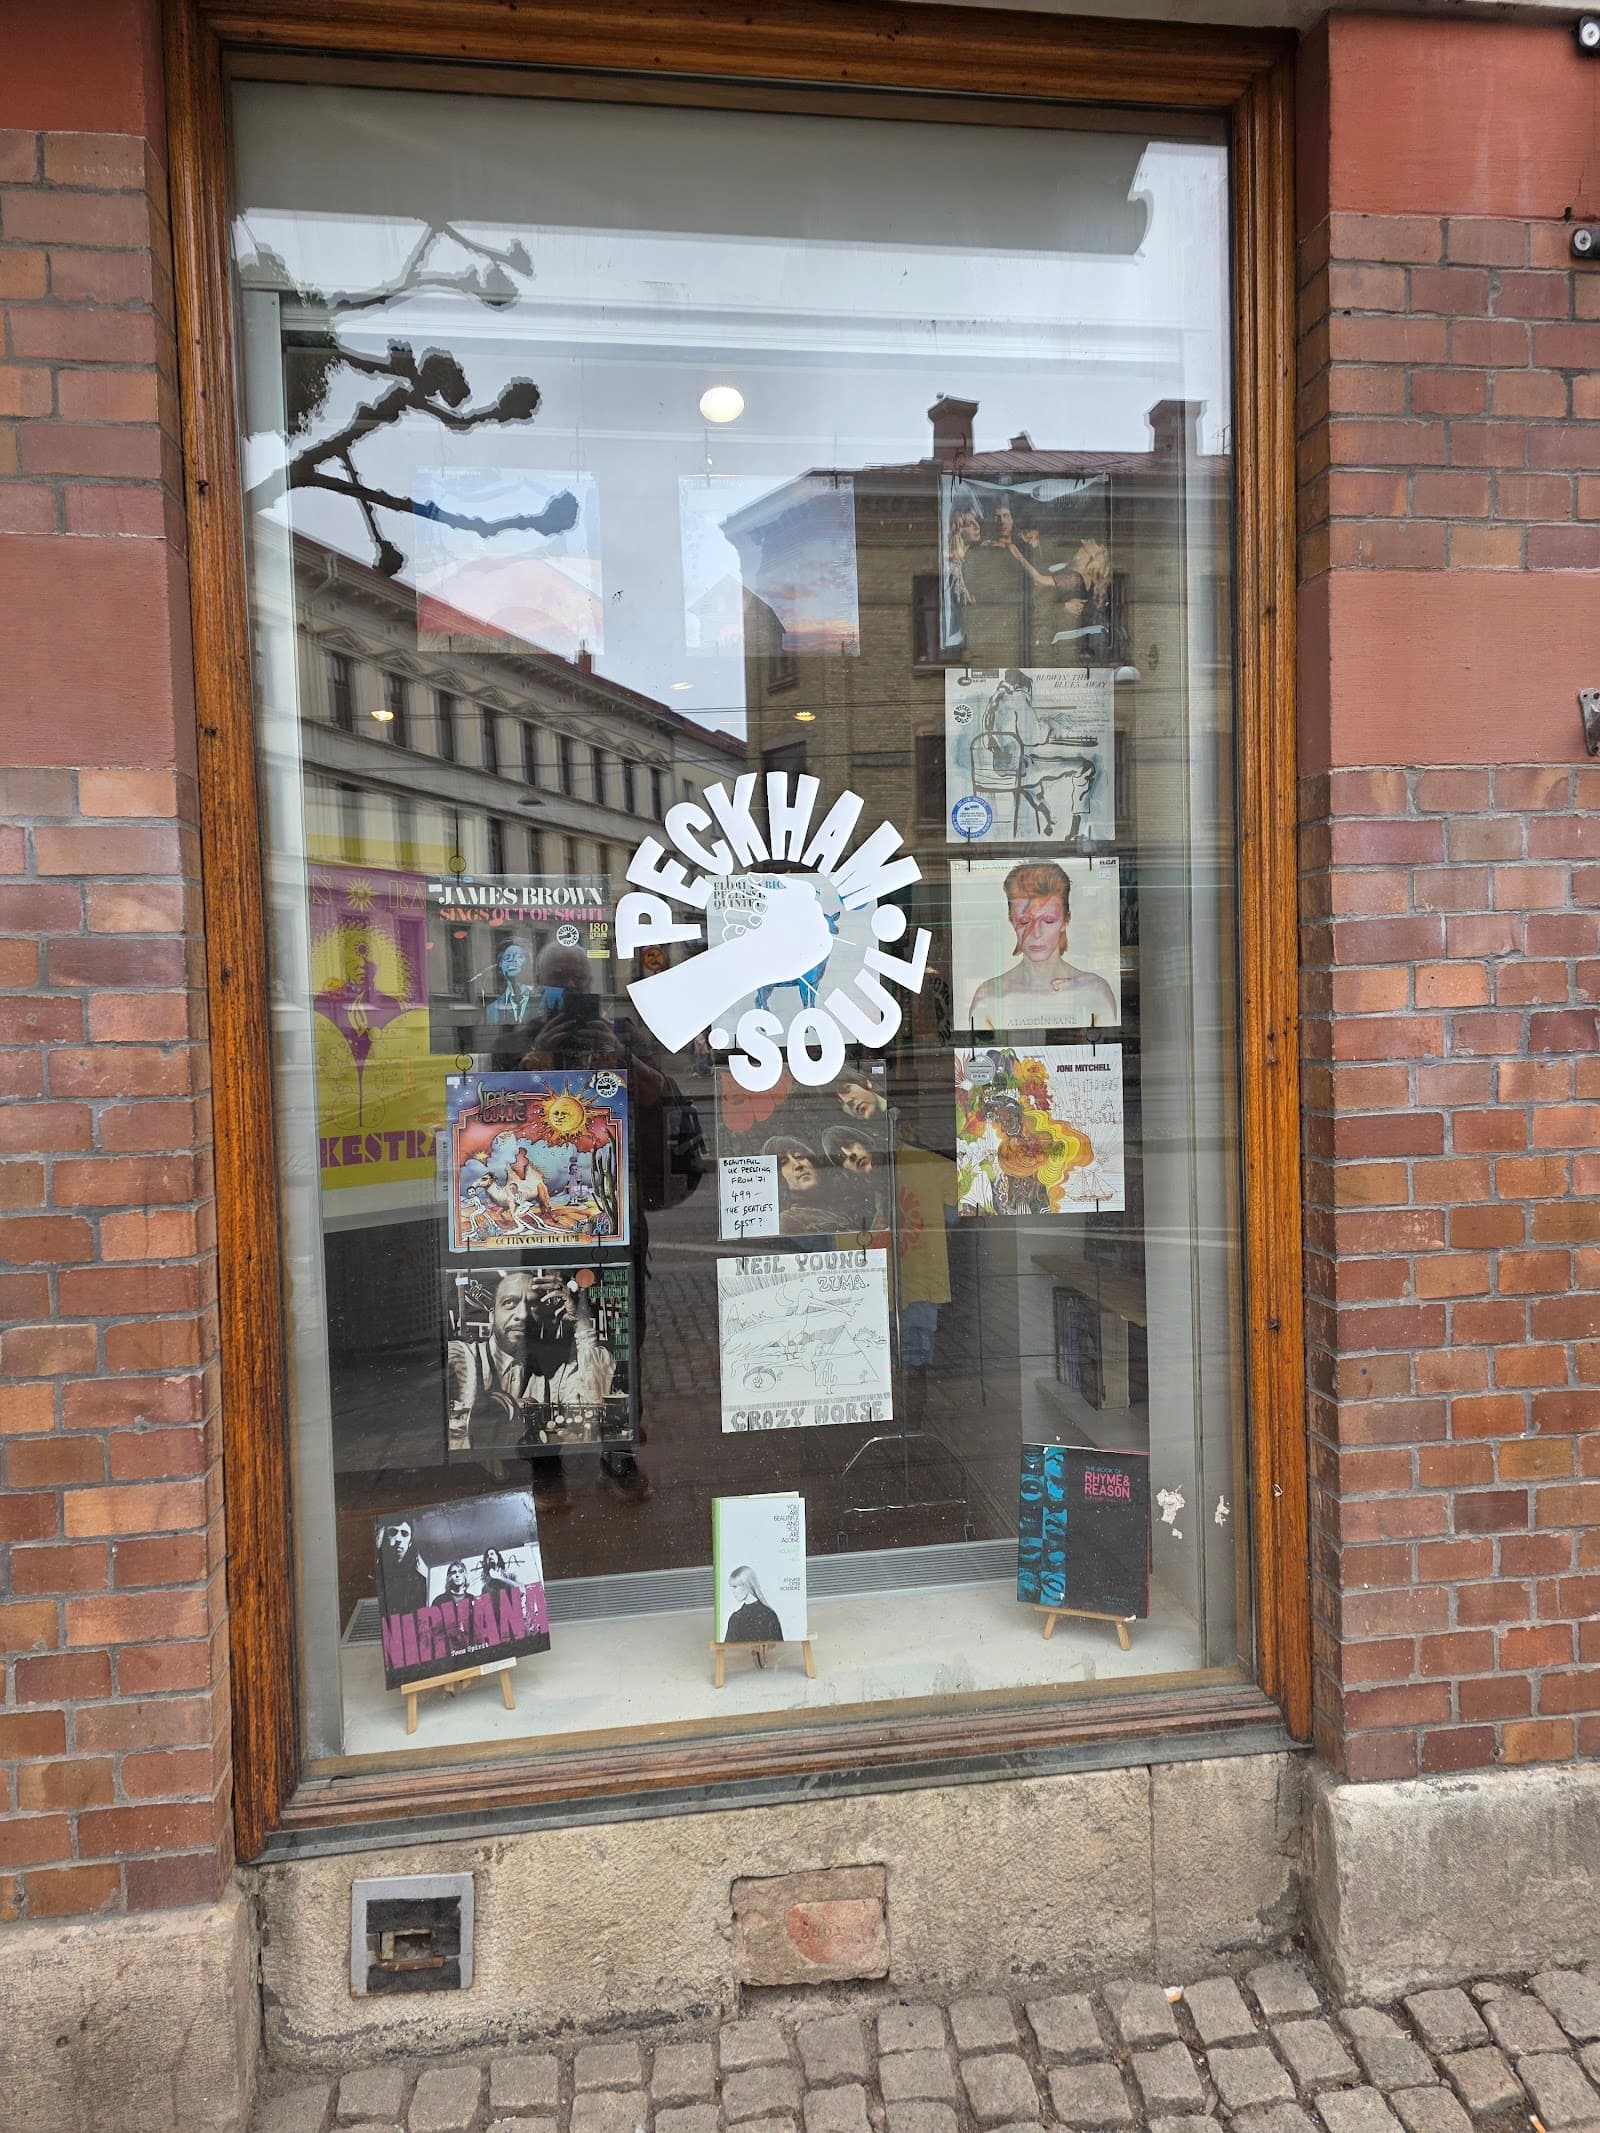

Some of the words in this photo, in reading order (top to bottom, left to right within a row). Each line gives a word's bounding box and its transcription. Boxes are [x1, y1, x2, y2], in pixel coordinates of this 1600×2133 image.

[616, 771, 922, 959] PECKHAM
[439, 887, 517, 905] JAMES
[522, 887, 603, 905] BROWN
[440, 907, 490, 921] SINGS
[492, 907, 528, 921] OUT
[530, 907, 553, 921] OF
[555, 907, 606, 921] SIGHT
[589, 923, 608, 933] 180
[728, 927, 933, 1092] SOUL
[1057, 1064, 1073, 1072] JONI
[1075, 1064, 1111, 1072] MITCHELL
[726, 1206, 740, 1214] THE
[743, 1204, 773, 1216] BEATLES
[795, 1253, 868, 1274] YOUNG
[731, 1407, 806, 1431] CRAZY
[814, 1401, 885, 1424] HORSE
[1084, 1483, 1131, 1499] REASON
[381, 1582, 549, 1669] NIRVANA
[467, 1642, 489, 1653] Spirit
